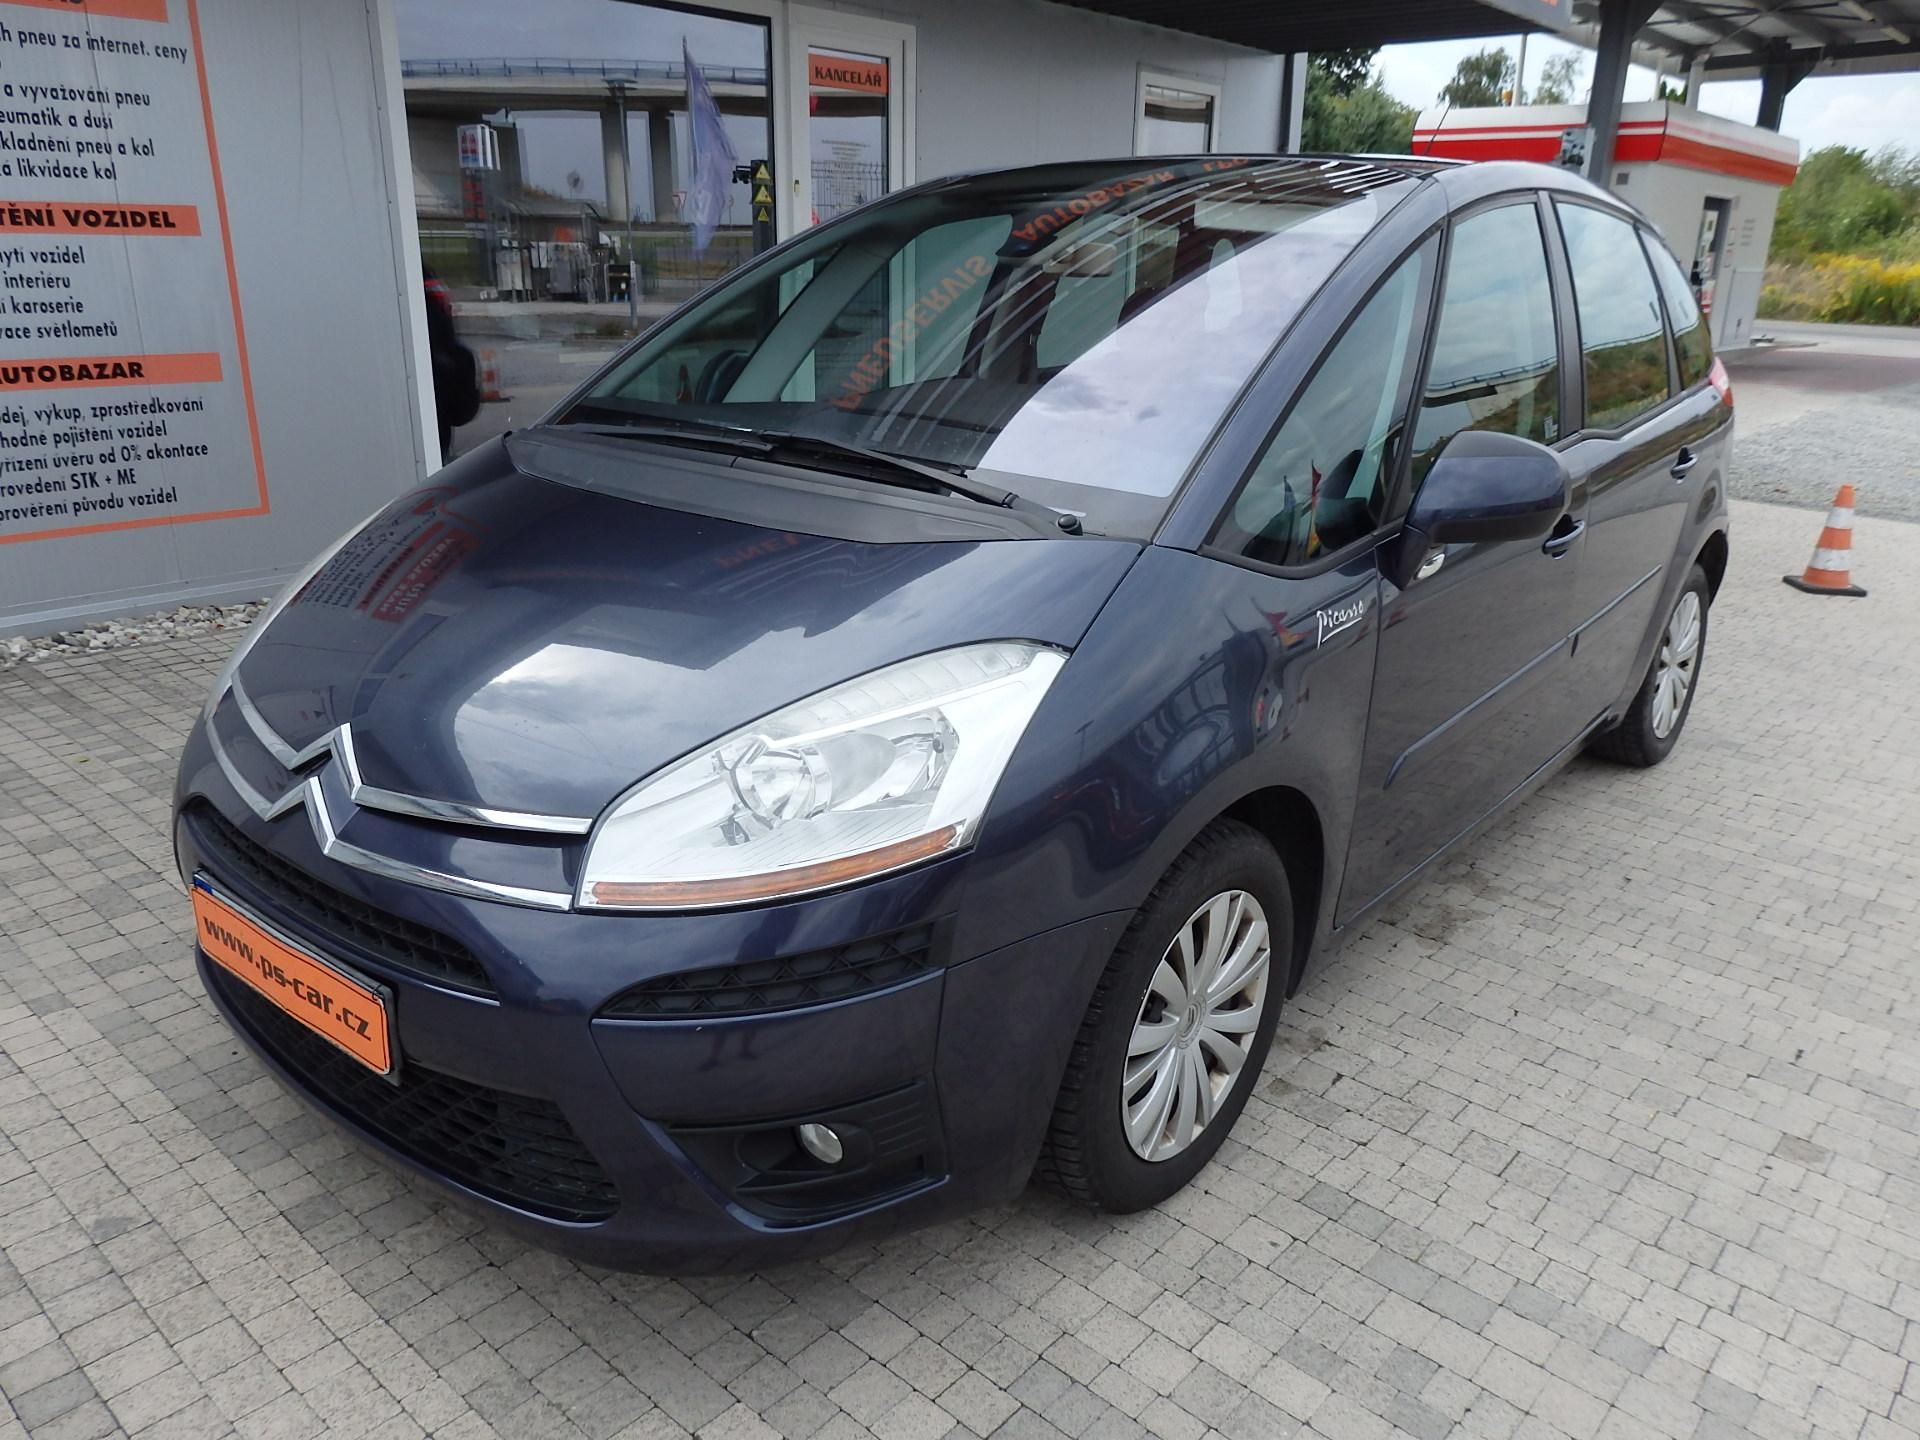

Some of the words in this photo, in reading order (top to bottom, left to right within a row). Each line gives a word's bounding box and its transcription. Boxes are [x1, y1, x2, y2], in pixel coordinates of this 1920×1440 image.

[18, 30, 57, 48] pneu
[62, 34, 81, 49] za
[86, 31, 150, 56] internet.
[154, 44, 188, 64] ceny
[815, 65, 882, 87] KANCELÁŘ
[4, 83, 14, 97] a
[115, 91, 151, 109] pneu
[68, 114, 78, 128] a
[0, 130, 71, 154] kladnění
[76, 140, 112, 158] pneu
[118, 142, 127, 156] a
[131, 136, 155, 157] kol
[17, 157, 89, 180] likvidace
[93, 161, 117, 181] kol
[63, 208, 177, 229] VOZIDEL
[30, 245, 86, 265] vozidel
[10, 295, 84, 314] karoserie
[117, 419, 168, 439] vozidel
[99, 448, 116, 465] od
[121, 443, 142, 462] 0%
[146, 442, 209, 461] akontace
[71, 470, 100, 490] STK
[105, 475, 112, 484] +
[117, 468, 137, 486] ME
[73, 491, 124, 517] původu
[128, 486, 178, 507] vozidel
[1316, 600, 1363, 650] Picasso
[203, 916, 372, 1042] www.ps-car.cz
